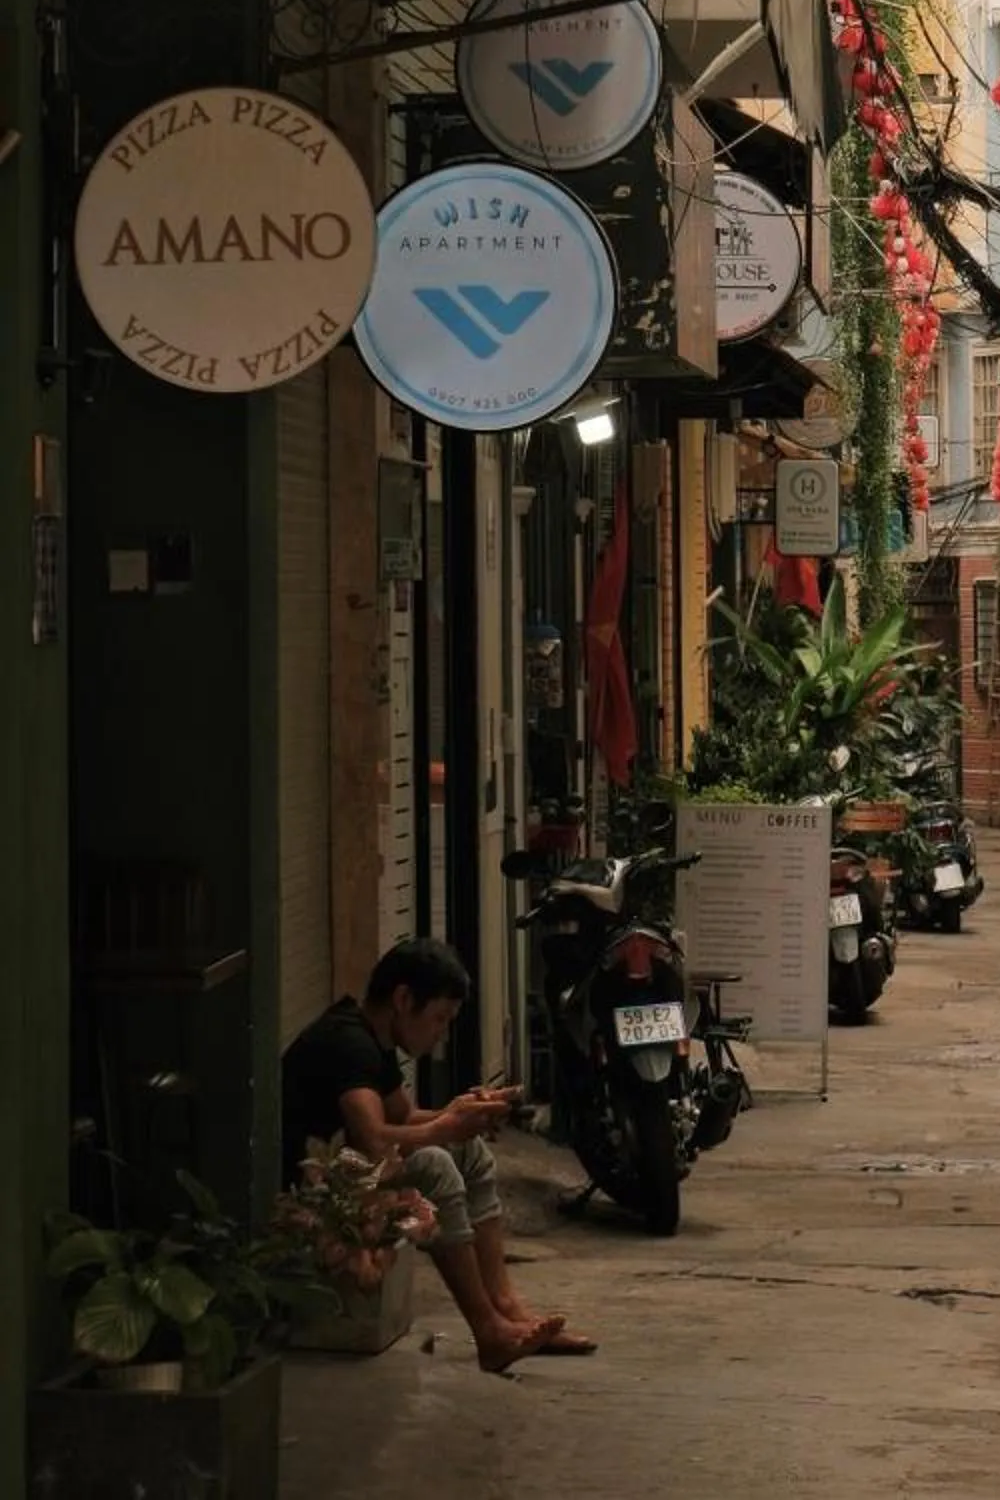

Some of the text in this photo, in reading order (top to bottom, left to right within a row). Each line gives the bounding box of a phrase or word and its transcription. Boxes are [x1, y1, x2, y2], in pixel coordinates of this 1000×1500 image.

[109, 96, 328, 173] PIZZA PIZZA
[434, 198, 530, 229] WISH
[101, 212, 351, 267] AMANO
[399, 235, 563, 253] APARTMENT
[715, 263, 771, 281] OUSE
[120, 309, 340, 385] PIZZA PIZZA
[696, 809, 742, 825] MENU
